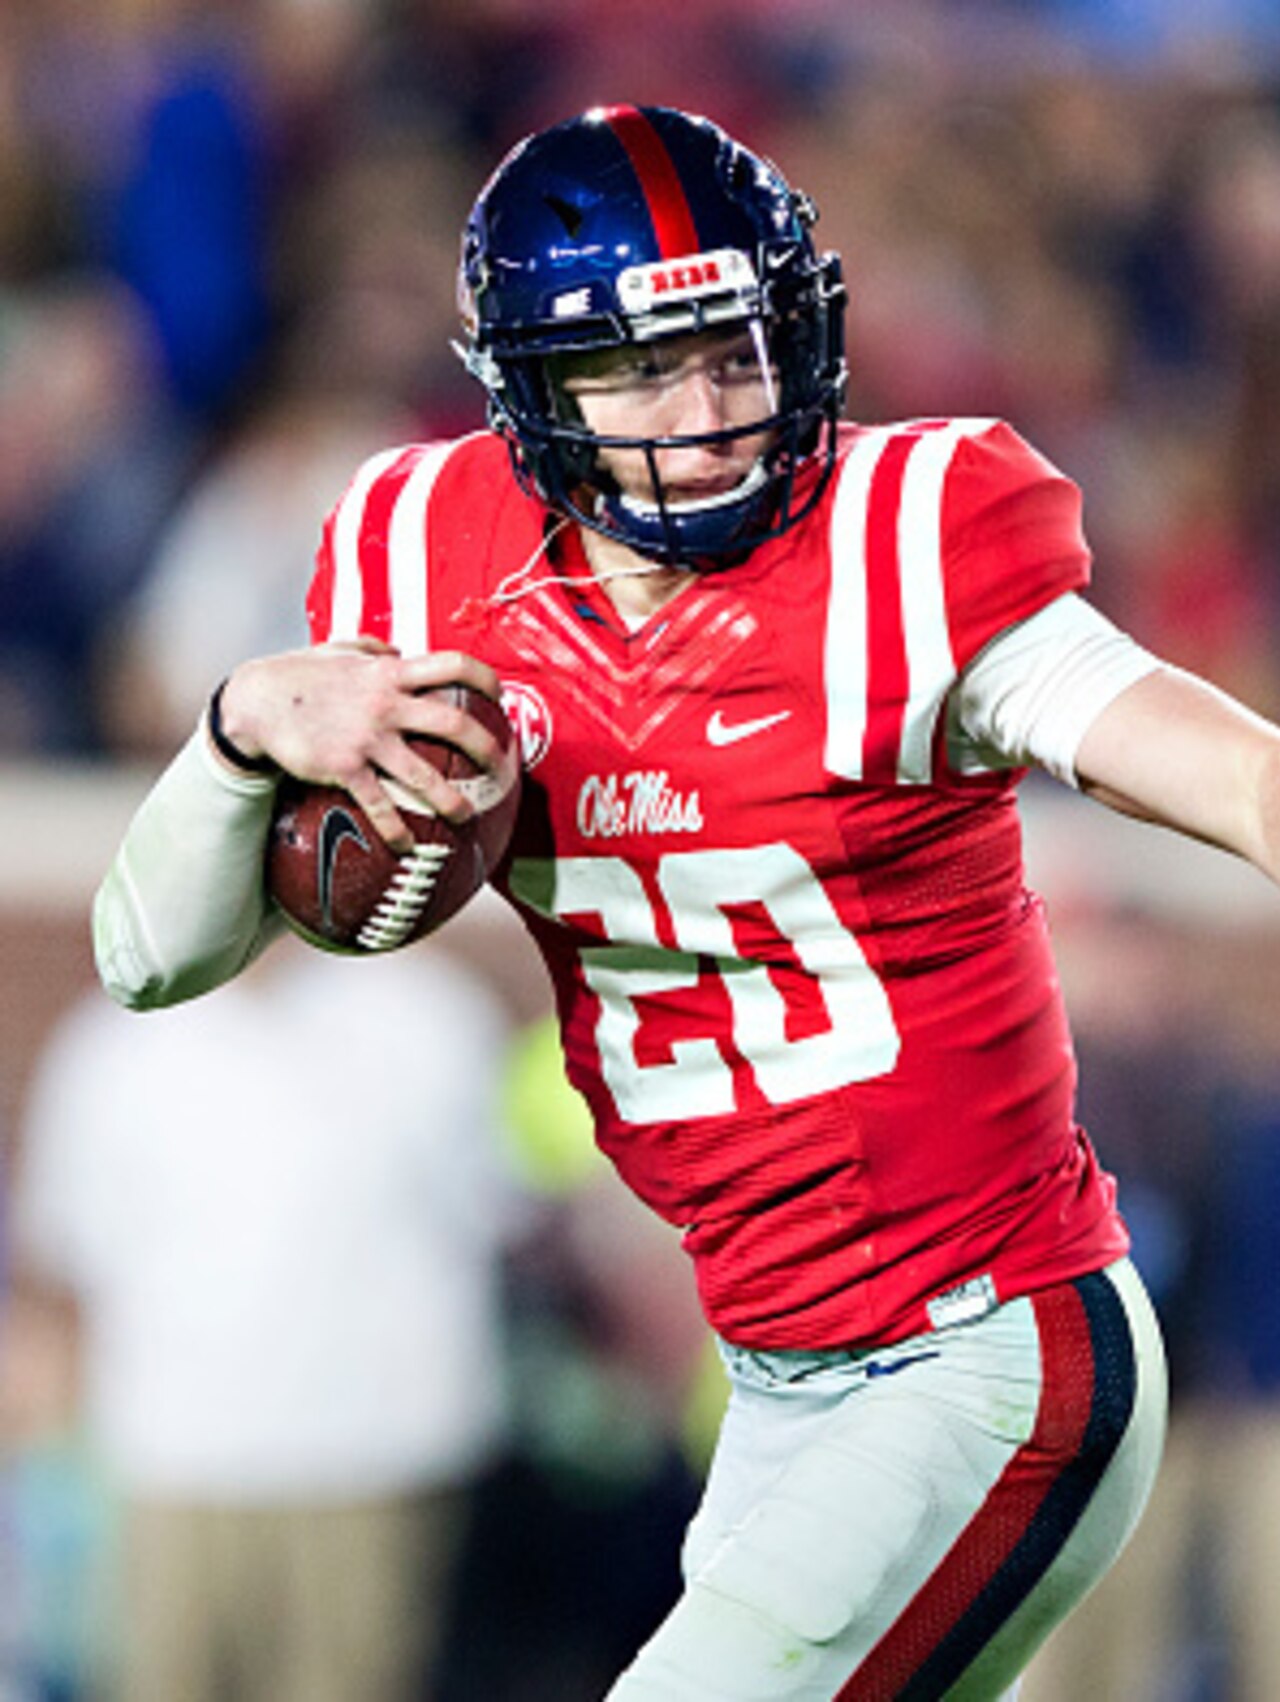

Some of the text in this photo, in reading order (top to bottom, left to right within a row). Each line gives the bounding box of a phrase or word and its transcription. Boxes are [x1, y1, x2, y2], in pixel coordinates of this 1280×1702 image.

[577, 769, 704, 838] Ole Miss
[508, 842, 902, 1125] 20
